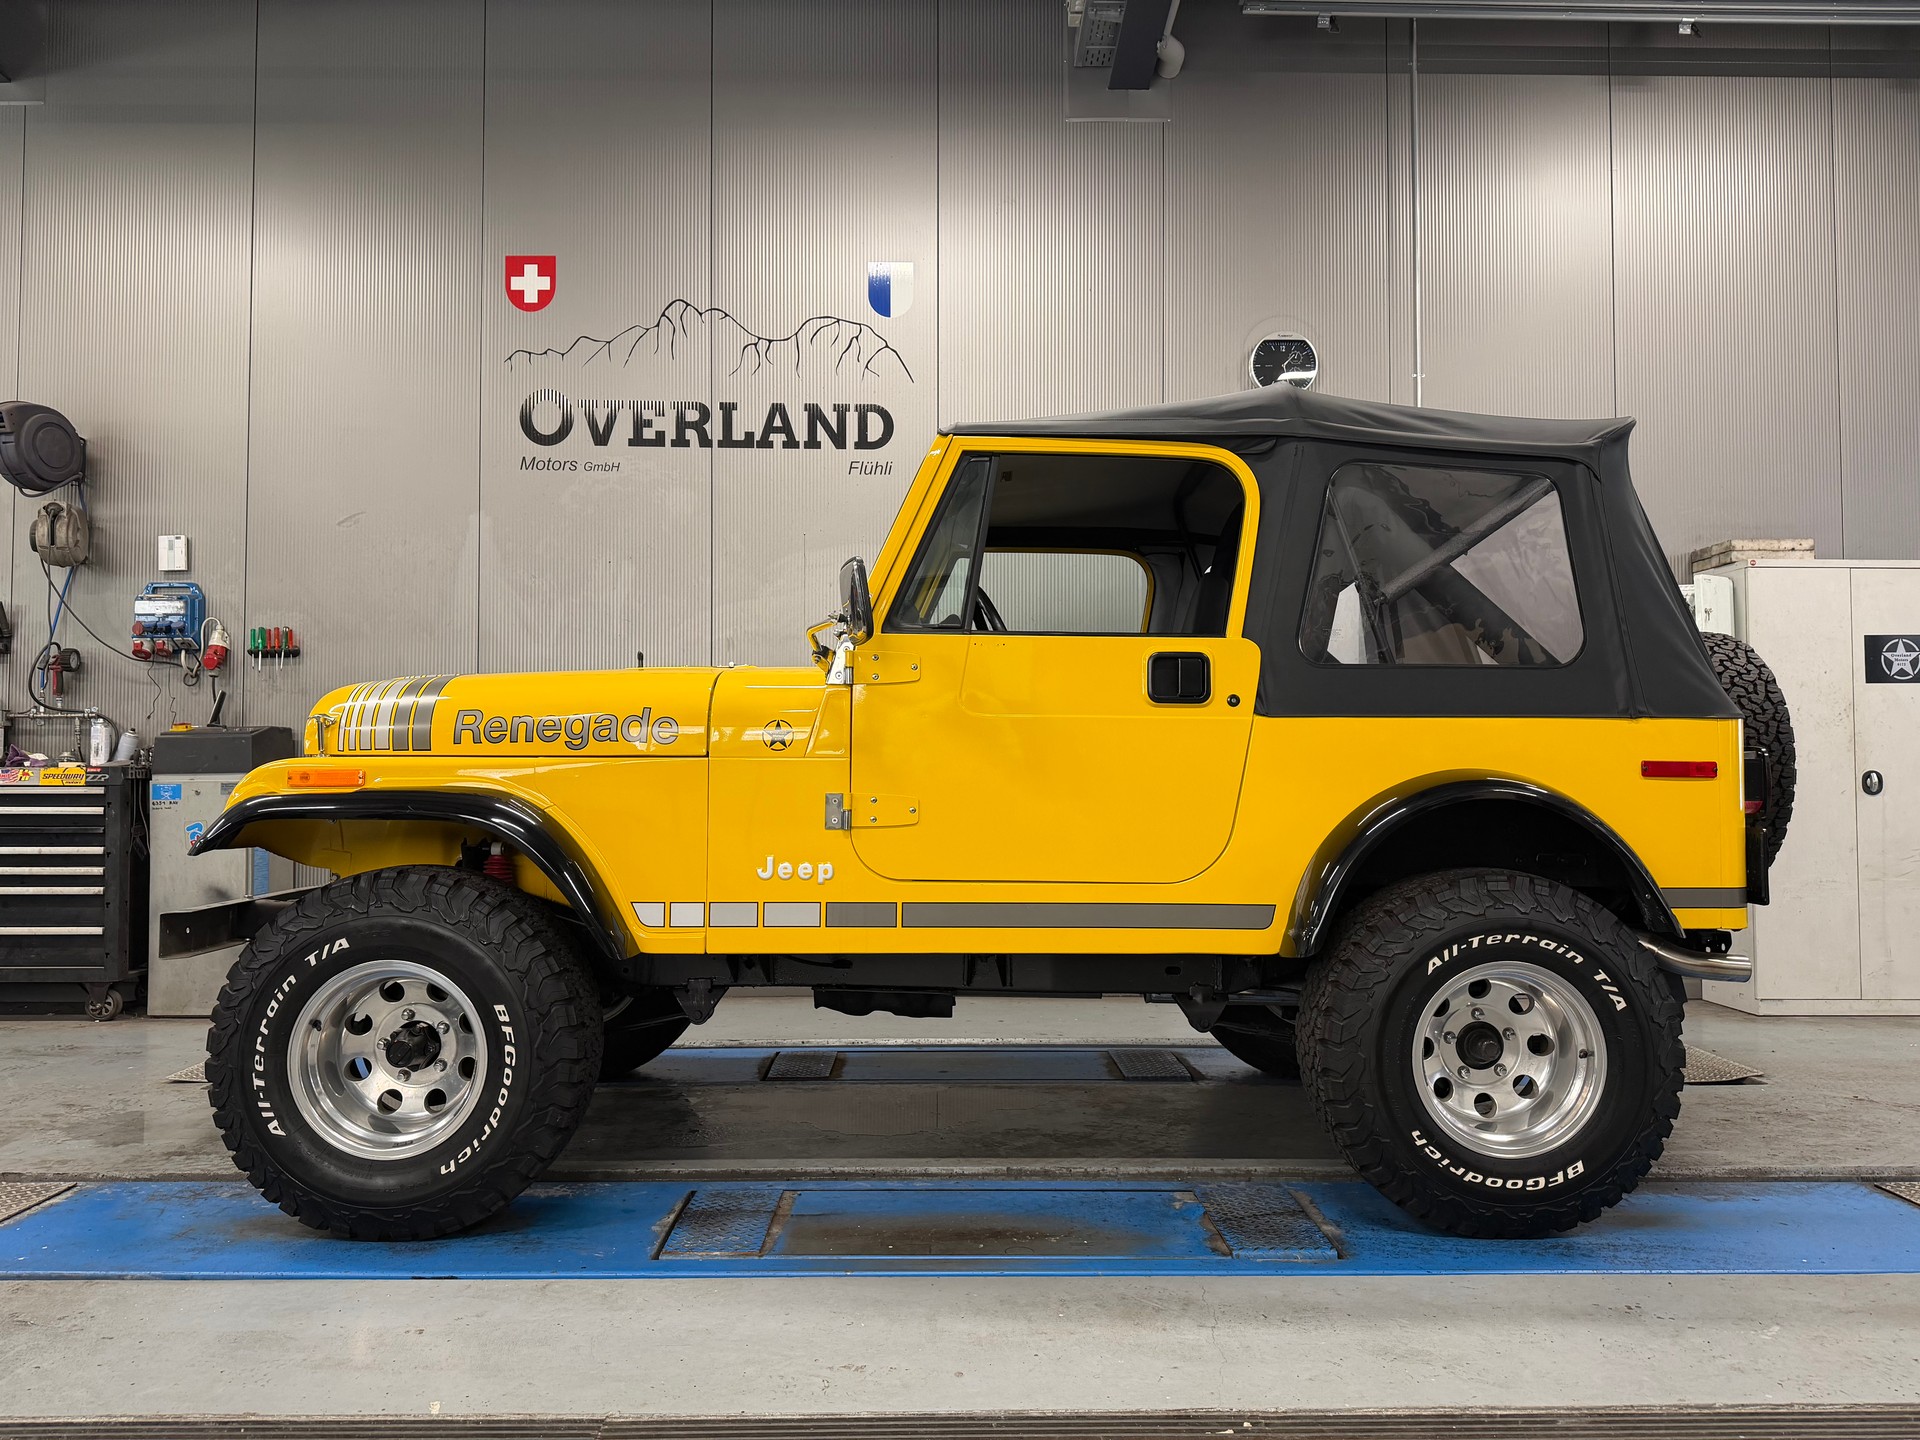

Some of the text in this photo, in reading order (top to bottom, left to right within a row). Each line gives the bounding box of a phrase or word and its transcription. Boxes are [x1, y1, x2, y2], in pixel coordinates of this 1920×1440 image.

[519, 388, 895, 450] OVERLAND
[519, 456, 621, 472] Motors GmbH
[848, 460, 893, 476] Flühli
[453, 707, 679, 751] Renegade
[42, 773, 85, 781] SPEEDWAY
[756, 856, 834, 885] Jeep
[1426, 933, 1629, 1012] All-Terrain T/A
[252, 937, 351, 1138] All-Terrain T/A
[439, 1003, 517, 1177] BFGoodrich
[1411, 1128, 1586, 1191] BFGoodrich
